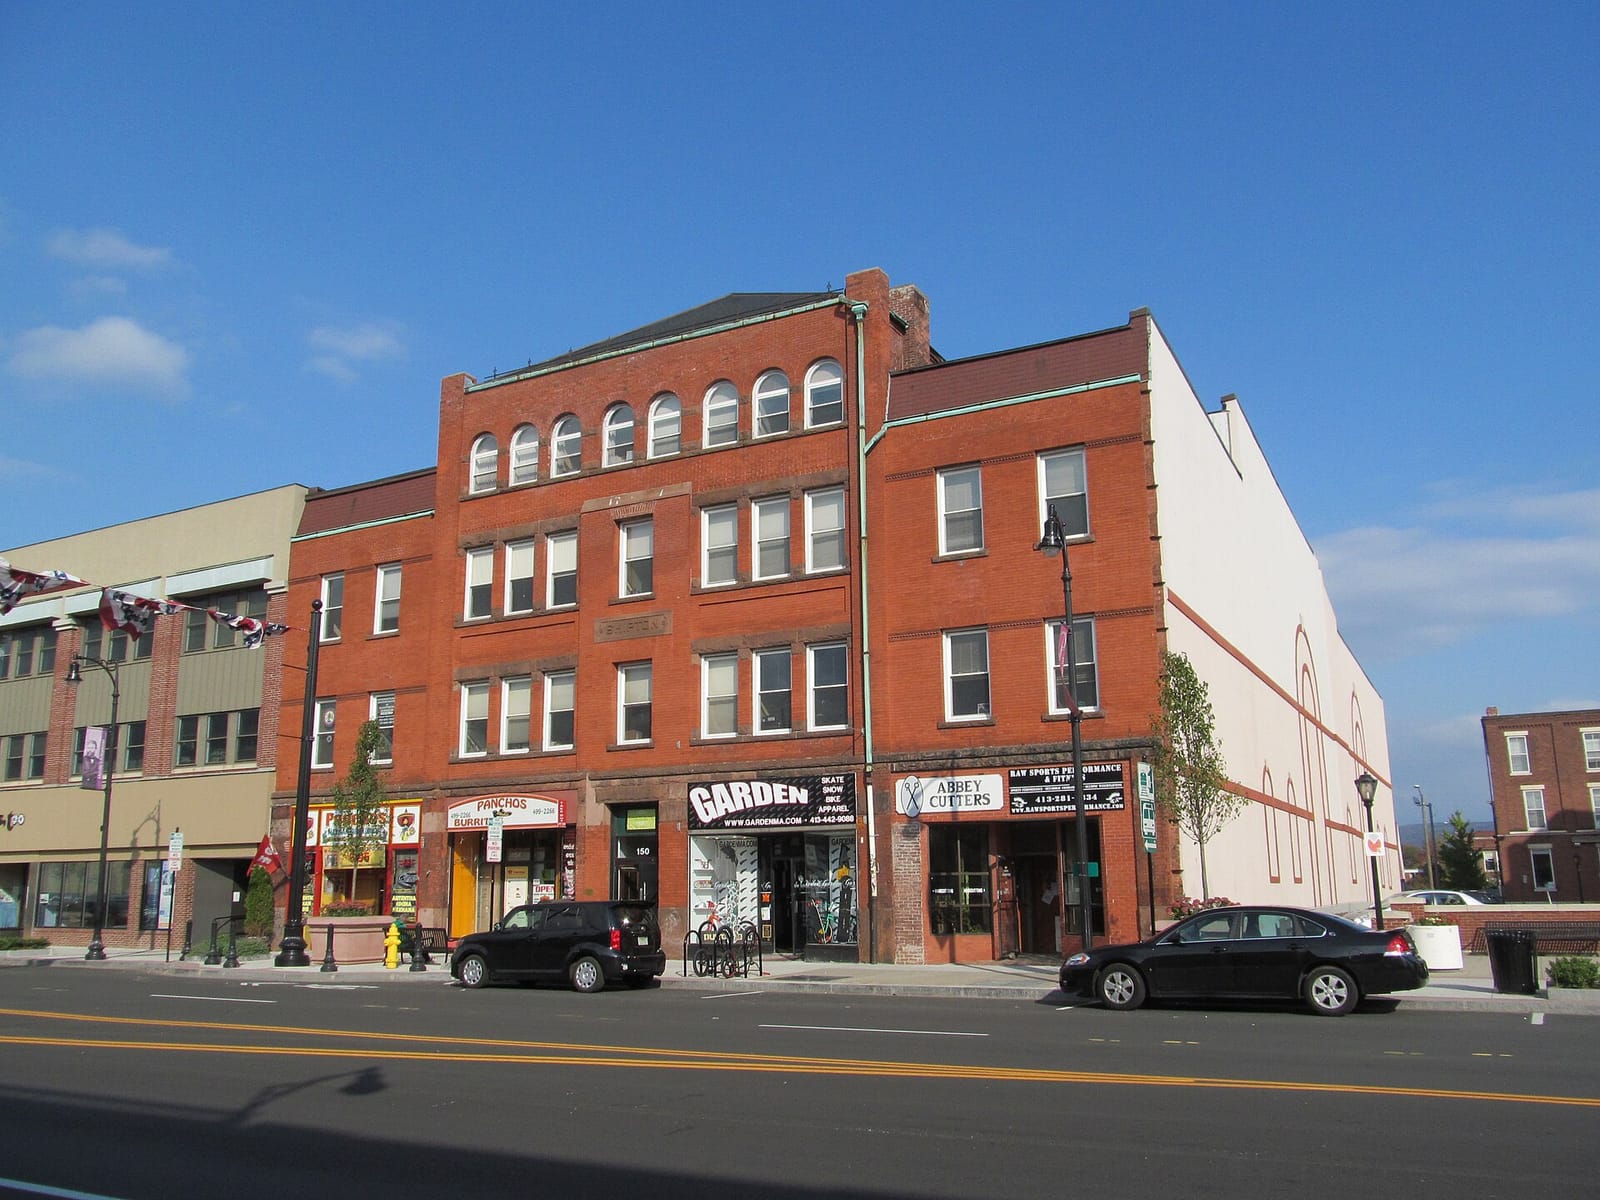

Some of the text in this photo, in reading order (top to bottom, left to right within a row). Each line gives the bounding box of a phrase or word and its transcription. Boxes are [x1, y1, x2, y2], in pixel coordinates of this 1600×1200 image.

[1010, 764, 1122, 777] RAW SPORTS PEORMANCE
[821, 776, 845, 784] SKATE
[937, 780, 982, 793] ABBEY
[689, 781, 808, 824] GARDEN
[929, 793, 991, 807] CUTTERS
[1035, 793, 1098, 803] 413-281-134
[477, 798, 528, 811] PANCHOS
[818, 805, 850, 813] APPAREL
[1011, 804, 1124, 813] WWW.RAWSPORTSPERRMANCE.COM
[454, 817, 489, 826] BURRIT
[724, 817, 802, 826] WWW.GARDENMA.COM
[636, 847, 650, 856] 150
